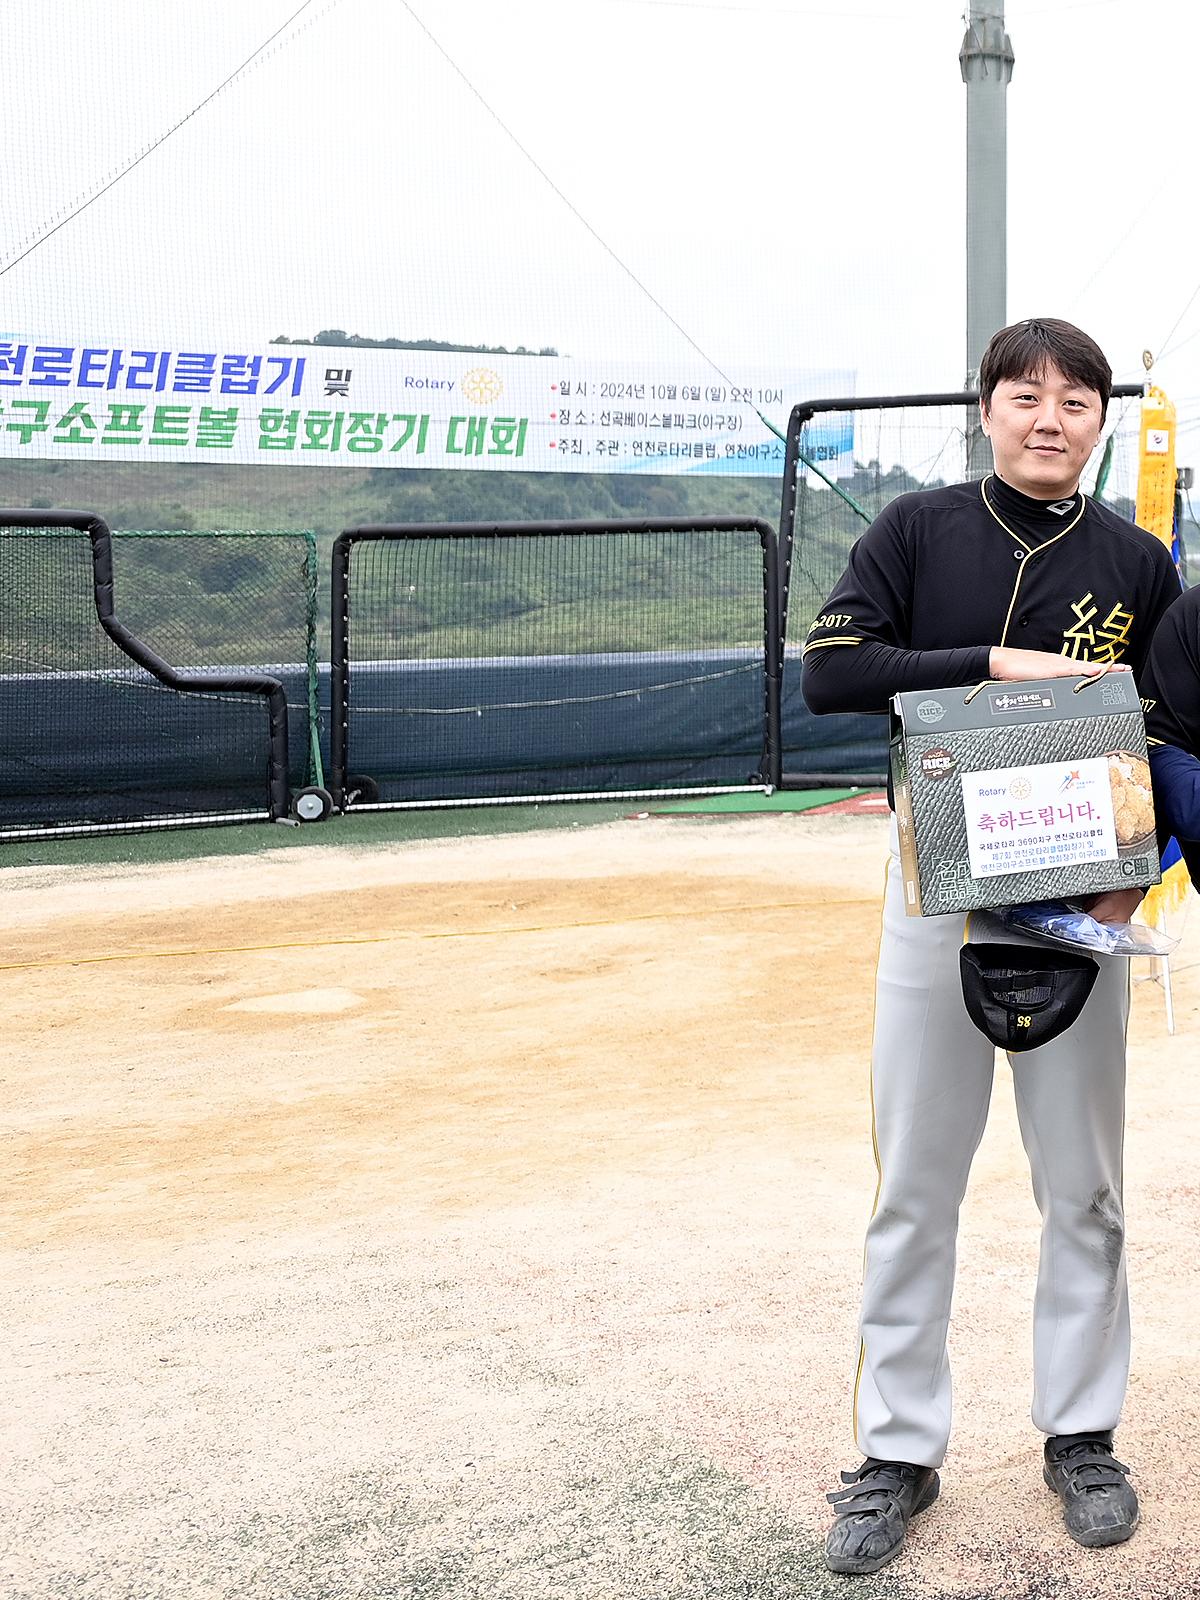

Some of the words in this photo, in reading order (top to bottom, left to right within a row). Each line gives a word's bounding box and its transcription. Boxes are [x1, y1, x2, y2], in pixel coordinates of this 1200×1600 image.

[324, 369, 352, 397] 및
[404, 376, 455, 391] Rotary
[600, 382, 645, 399] 2024년
[651, 384, 677, 400] 10월
[731, 387, 752, 403] 오전
[758, 389, 783, 404] 10시
[0, 399, 239, 449] 구소프트볼
[258, 408, 430, 454] 협회장기
[446, 416, 528, 457] 대회
[821, 614, 852, 628] 2017
[919, 706, 943, 717] RICE
[978, 788, 1007, 797] Rotary
[977, 801, 1101, 833] 축하드립니다.
